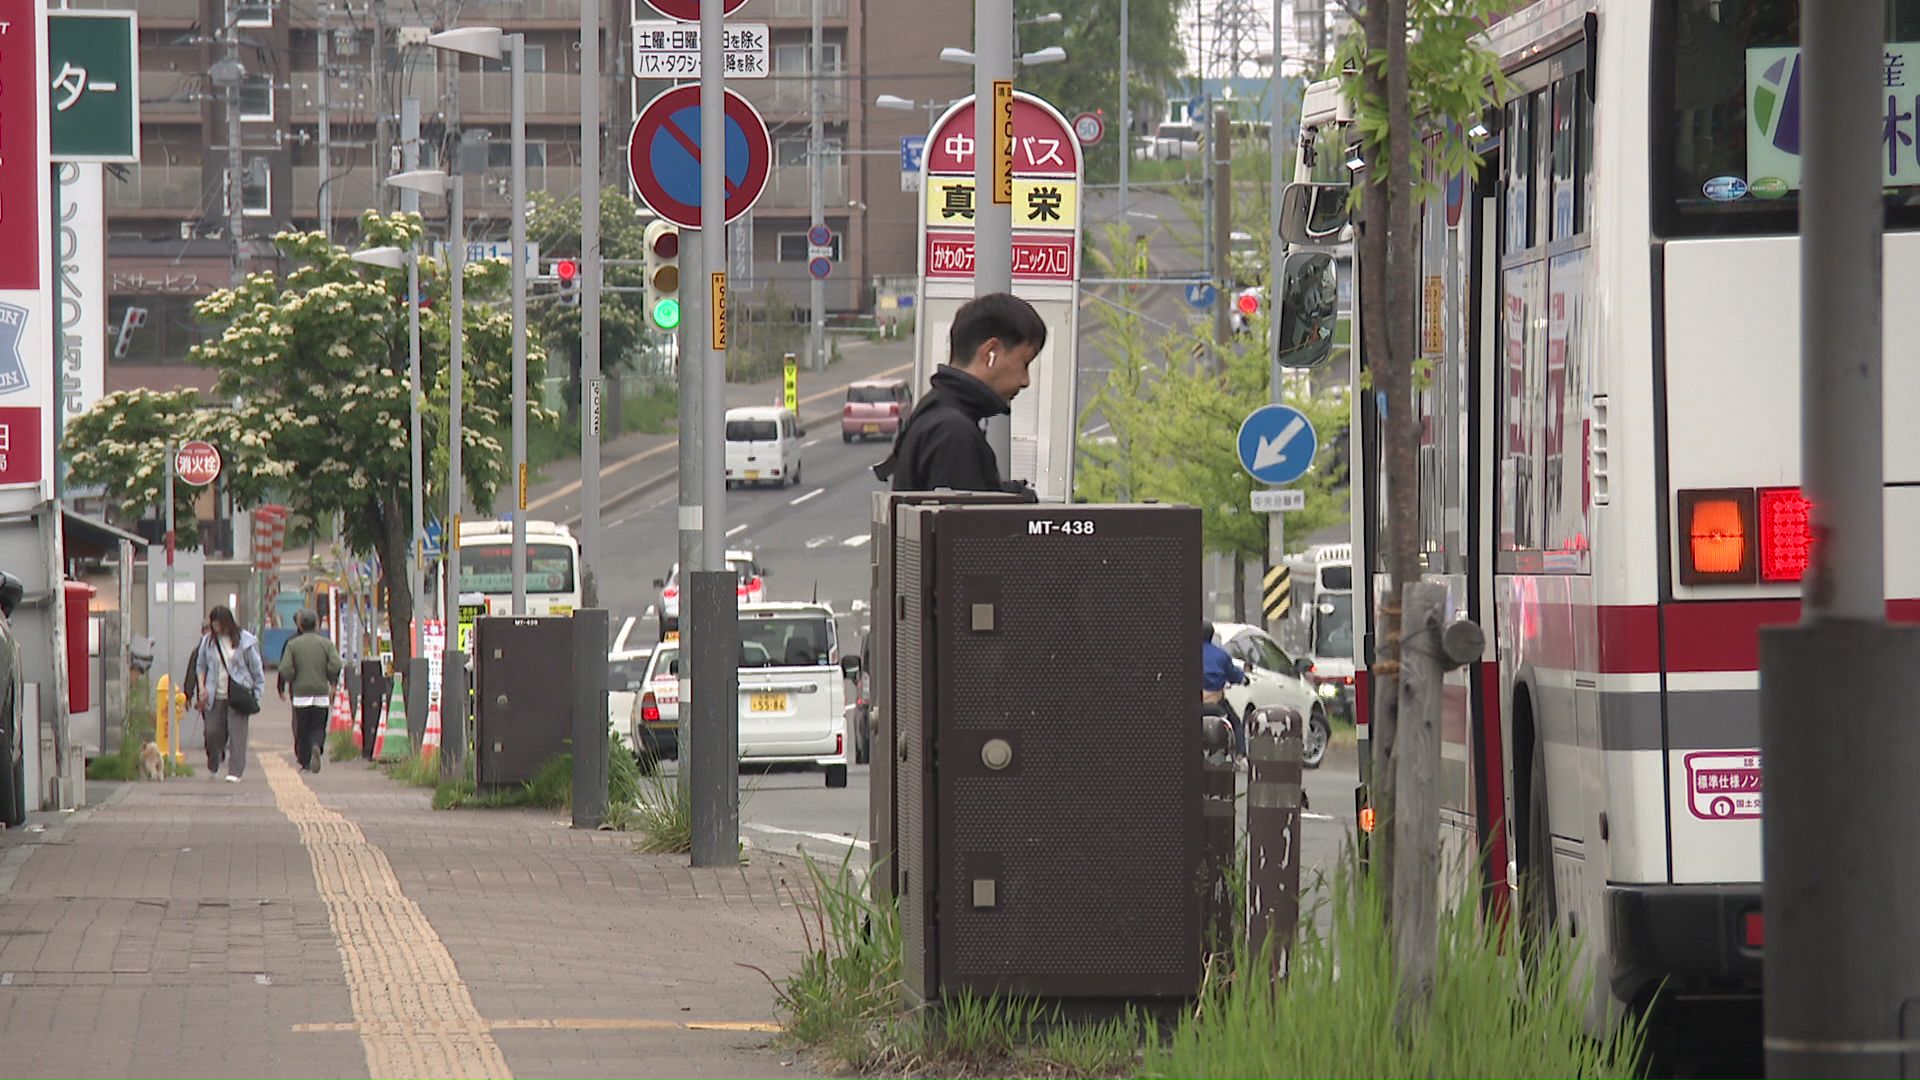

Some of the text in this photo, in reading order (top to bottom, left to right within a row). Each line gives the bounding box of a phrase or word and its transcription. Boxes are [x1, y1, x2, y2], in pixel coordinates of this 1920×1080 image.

[52, 62, 117, 111] ター
[1079, 119, 1097, 138] 50
[945, 132, 1064, 166] 中バス
[1004, 102, 1012, 197] 90423
[179, 455, 216, 474] 消火栓
[1028, 521, 1094, 535] MT-438
